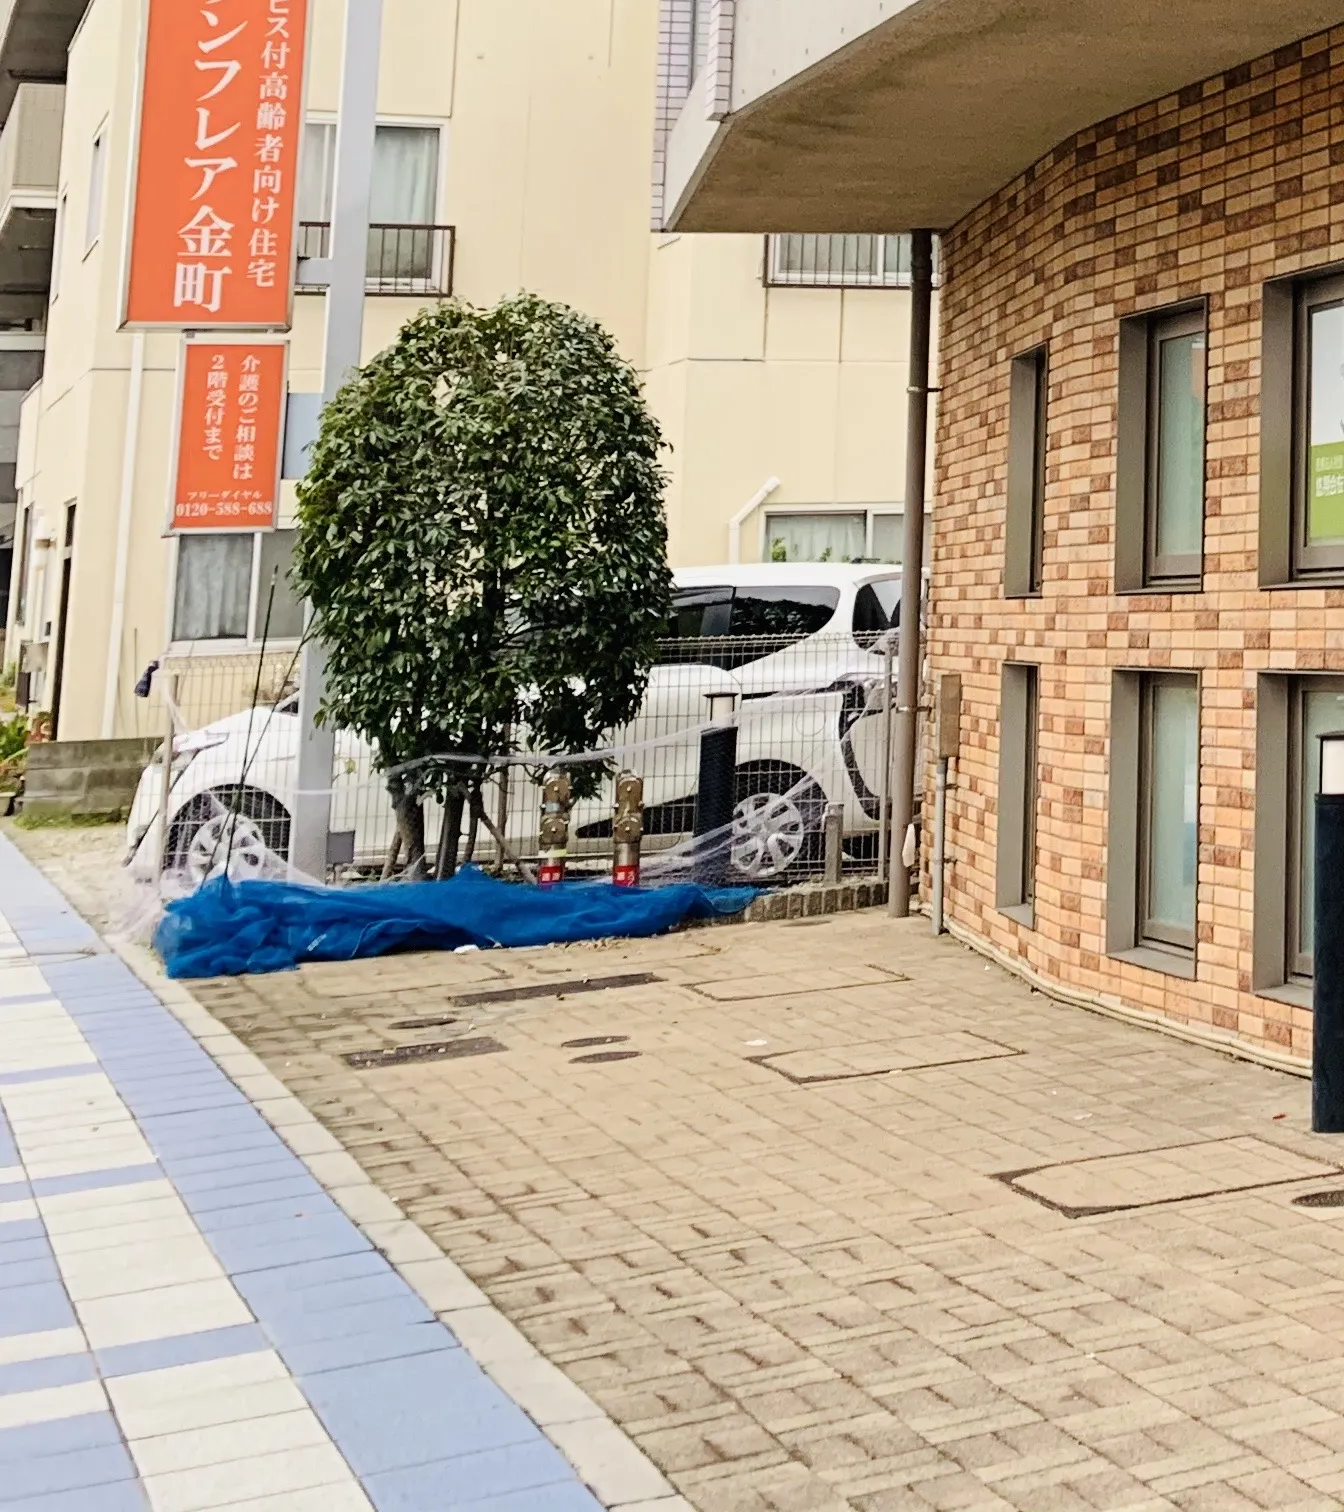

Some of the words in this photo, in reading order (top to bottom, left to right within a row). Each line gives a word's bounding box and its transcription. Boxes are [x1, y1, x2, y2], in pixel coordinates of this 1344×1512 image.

[202, 354, 229, 461] 2階受付まで
